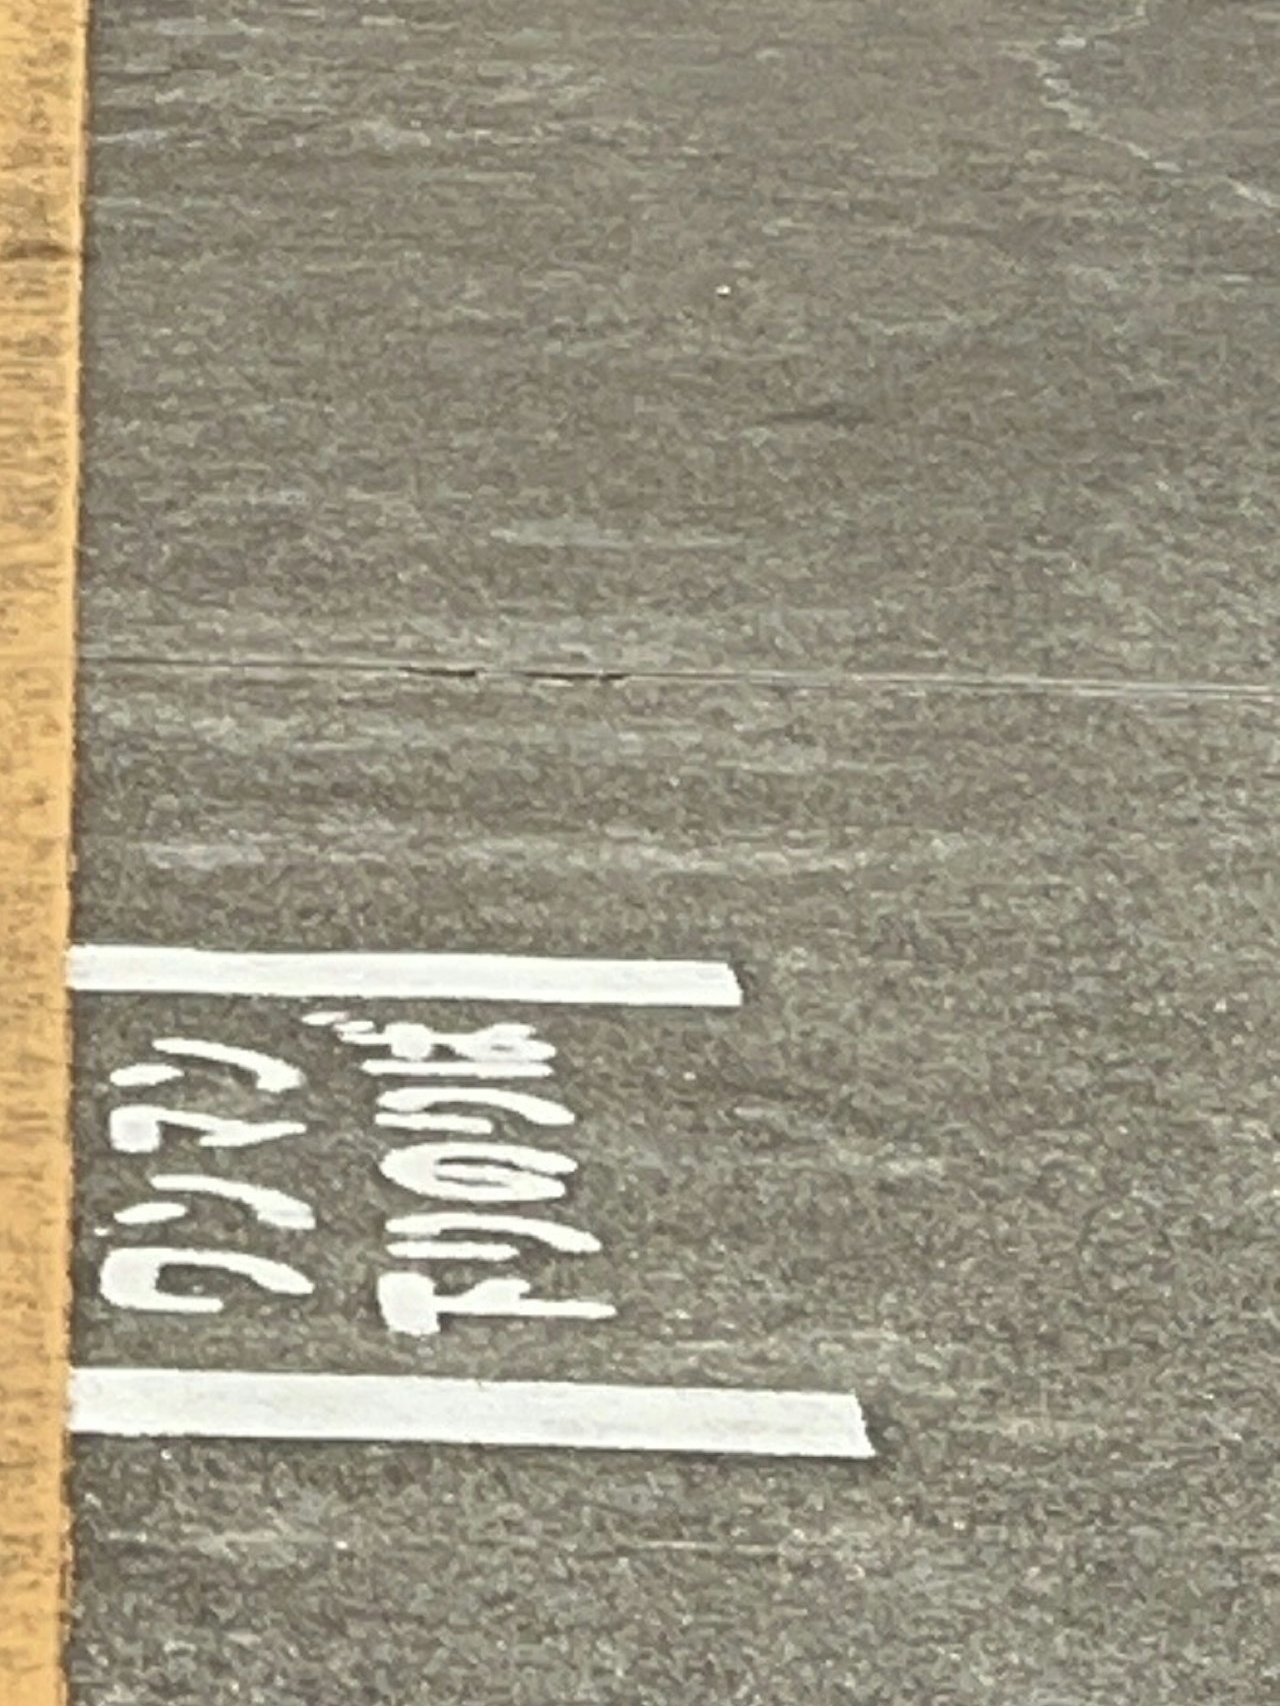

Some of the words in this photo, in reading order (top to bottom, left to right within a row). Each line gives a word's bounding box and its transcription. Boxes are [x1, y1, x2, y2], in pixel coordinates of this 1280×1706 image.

[95, 1036, 317, 1314] ワンマン
[300, 1010, 620, 1339] 下りのりば
